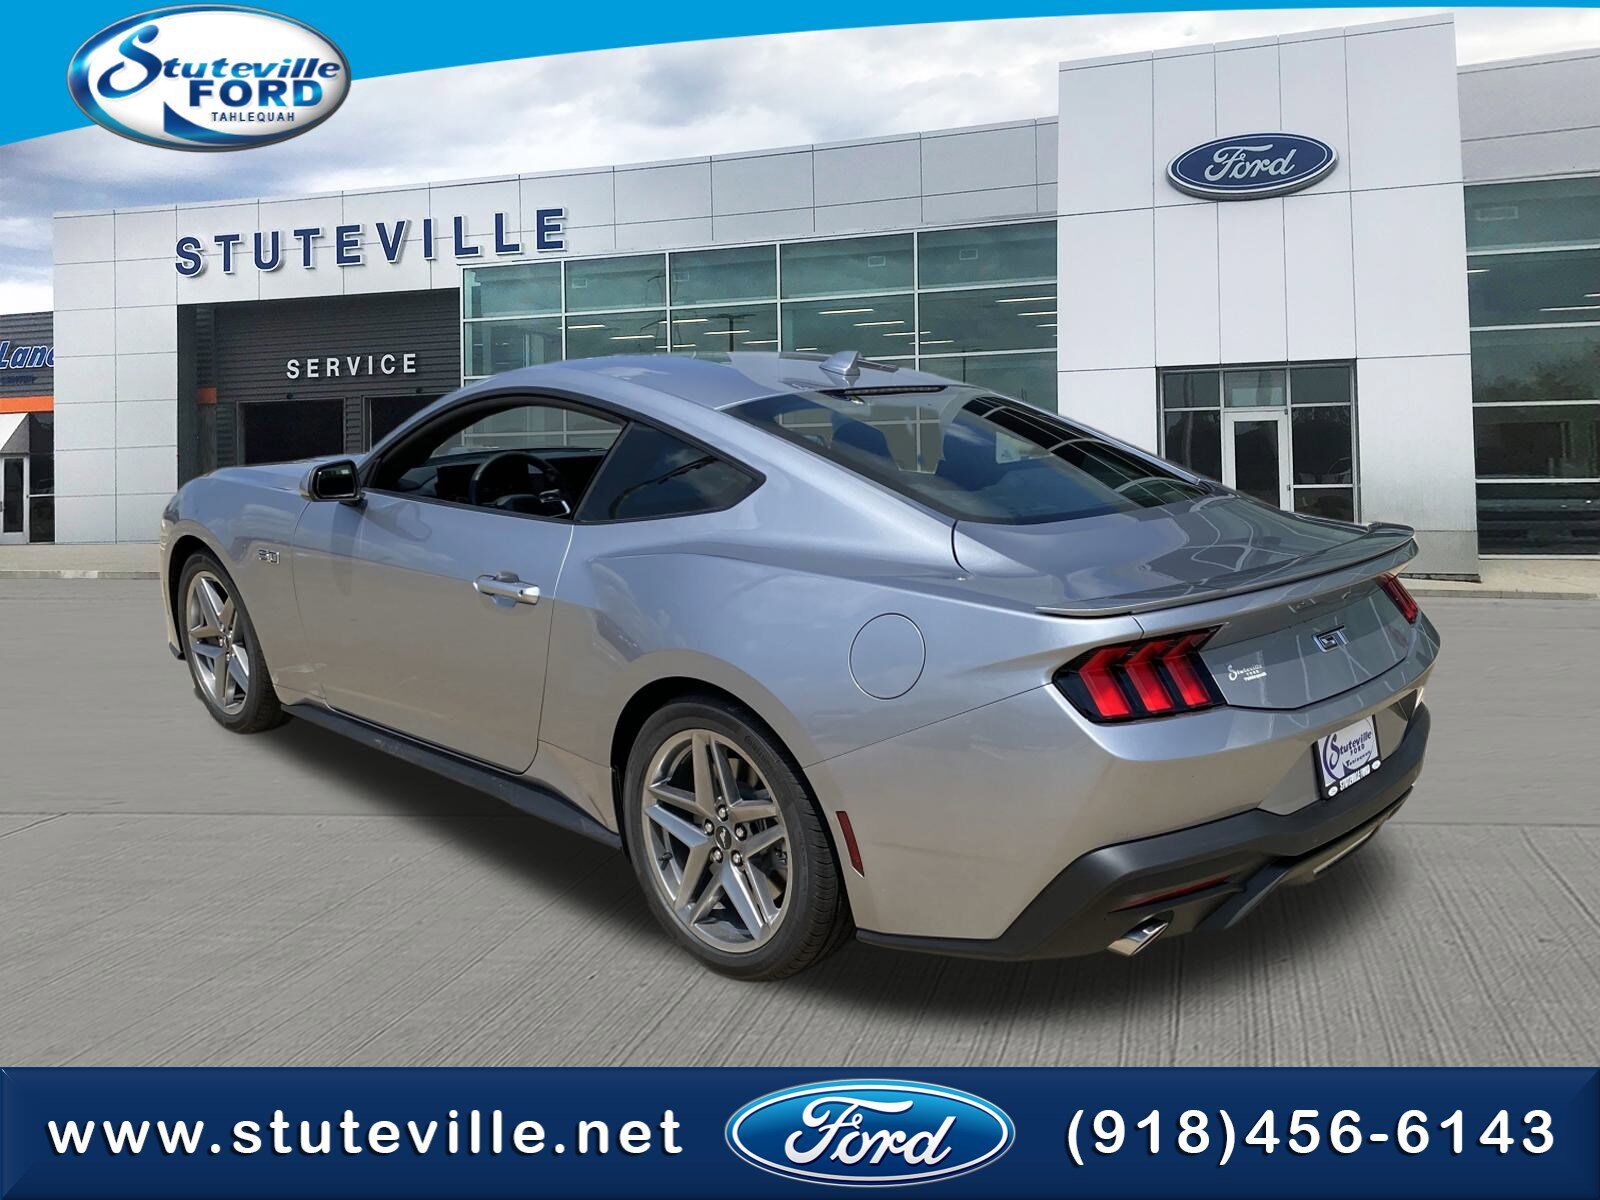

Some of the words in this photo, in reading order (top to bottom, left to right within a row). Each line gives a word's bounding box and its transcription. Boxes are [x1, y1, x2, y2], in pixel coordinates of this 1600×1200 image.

[1204, 143, 1297, 182] Ford
[175, 208, 567, 278] STUTEVILLE
[286, 353, 418, 380] SERVICE
[1329, 730, 1372, 770] Stuteville
